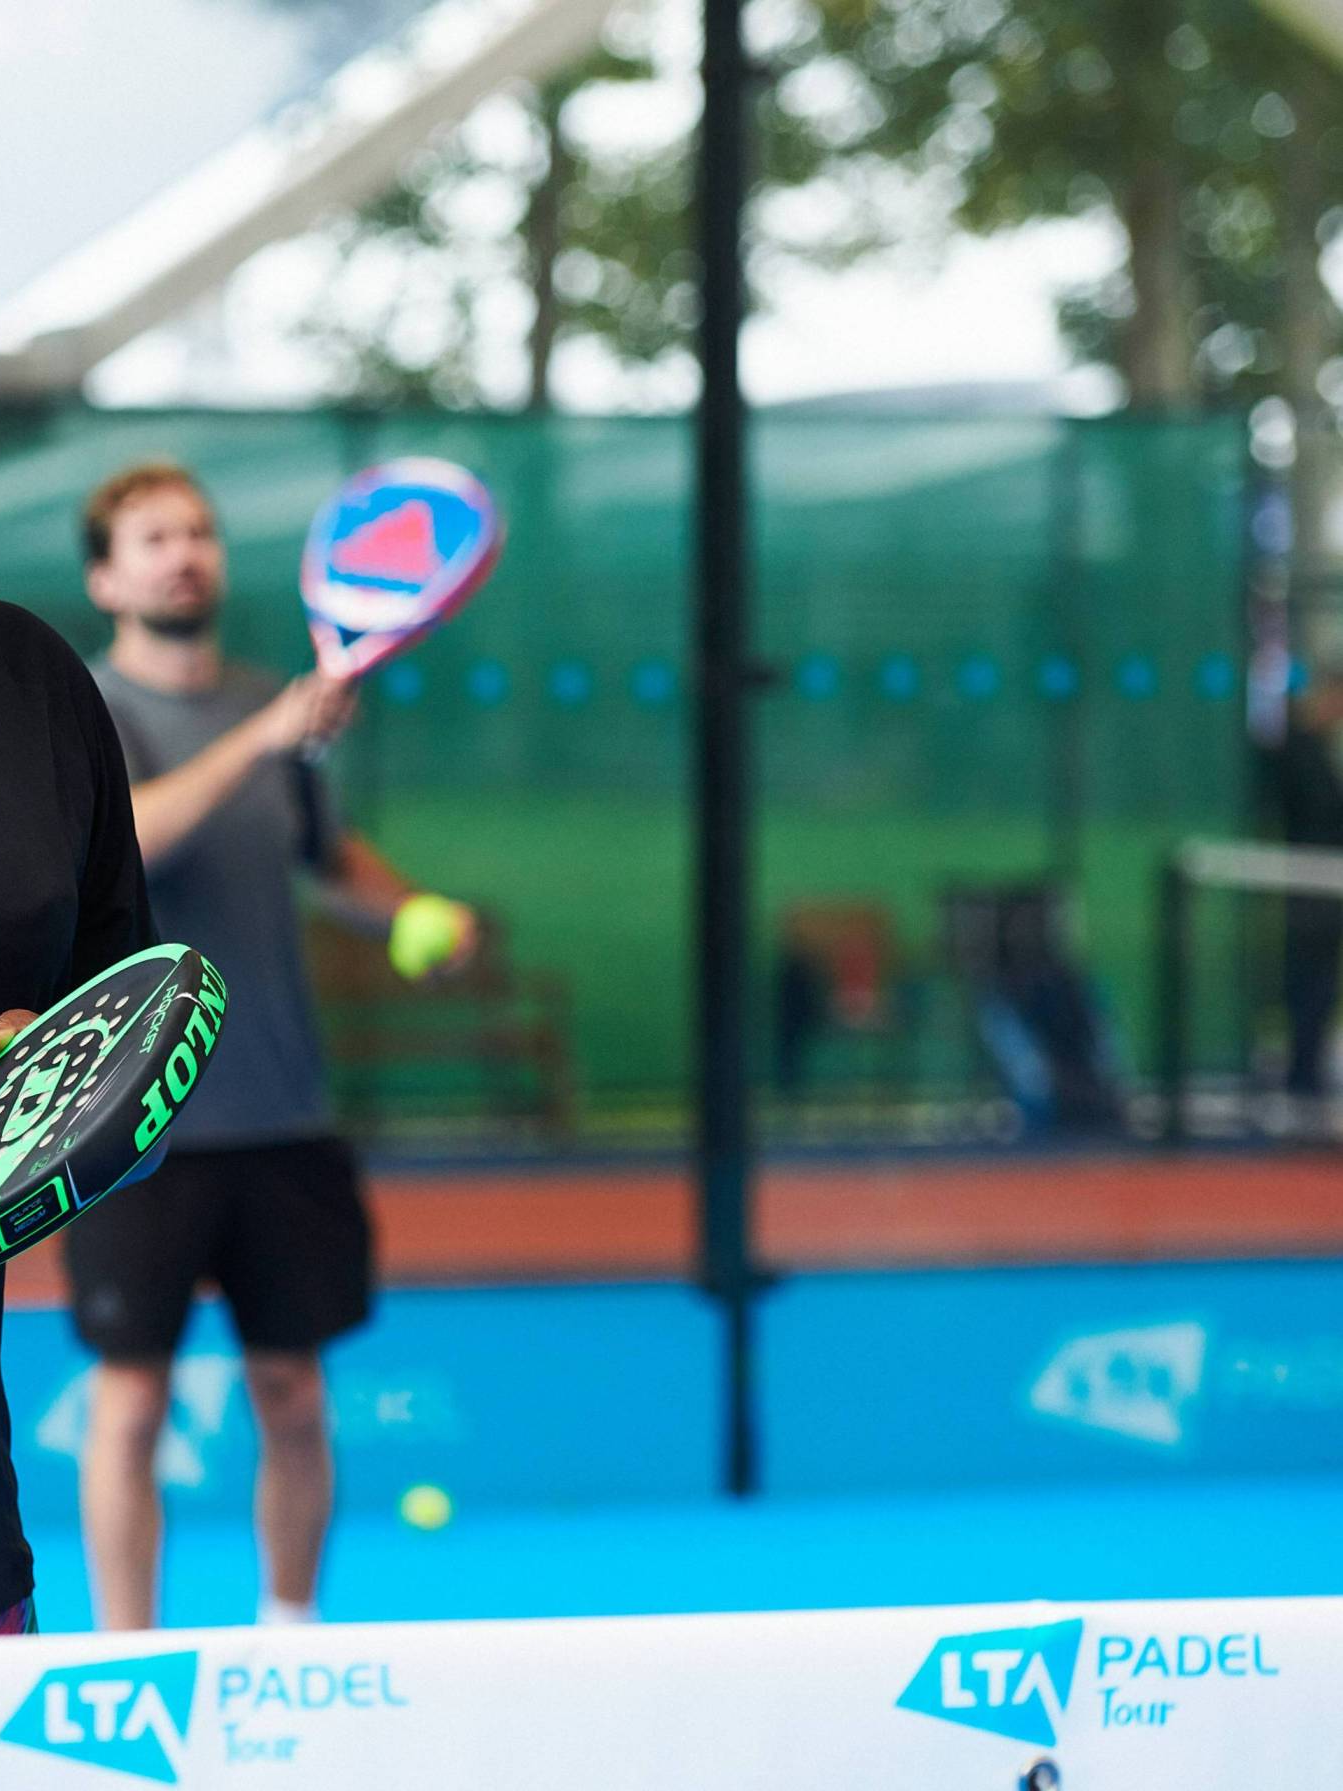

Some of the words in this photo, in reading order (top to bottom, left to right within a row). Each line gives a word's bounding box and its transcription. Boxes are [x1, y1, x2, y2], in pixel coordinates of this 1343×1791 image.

[139, 983, 179, 1054] ROCKET
[135, 955, 227, 1153] UNLOP
[217, 1662, 408, 1711] PADEL
[940, 1649, 1064, 1710] LTA
[1098, 1633, 1280, 1679] PADEL
[44, 1680, 185, 1745] LTA
[1099, 1686, 1175, 1729] Tour
